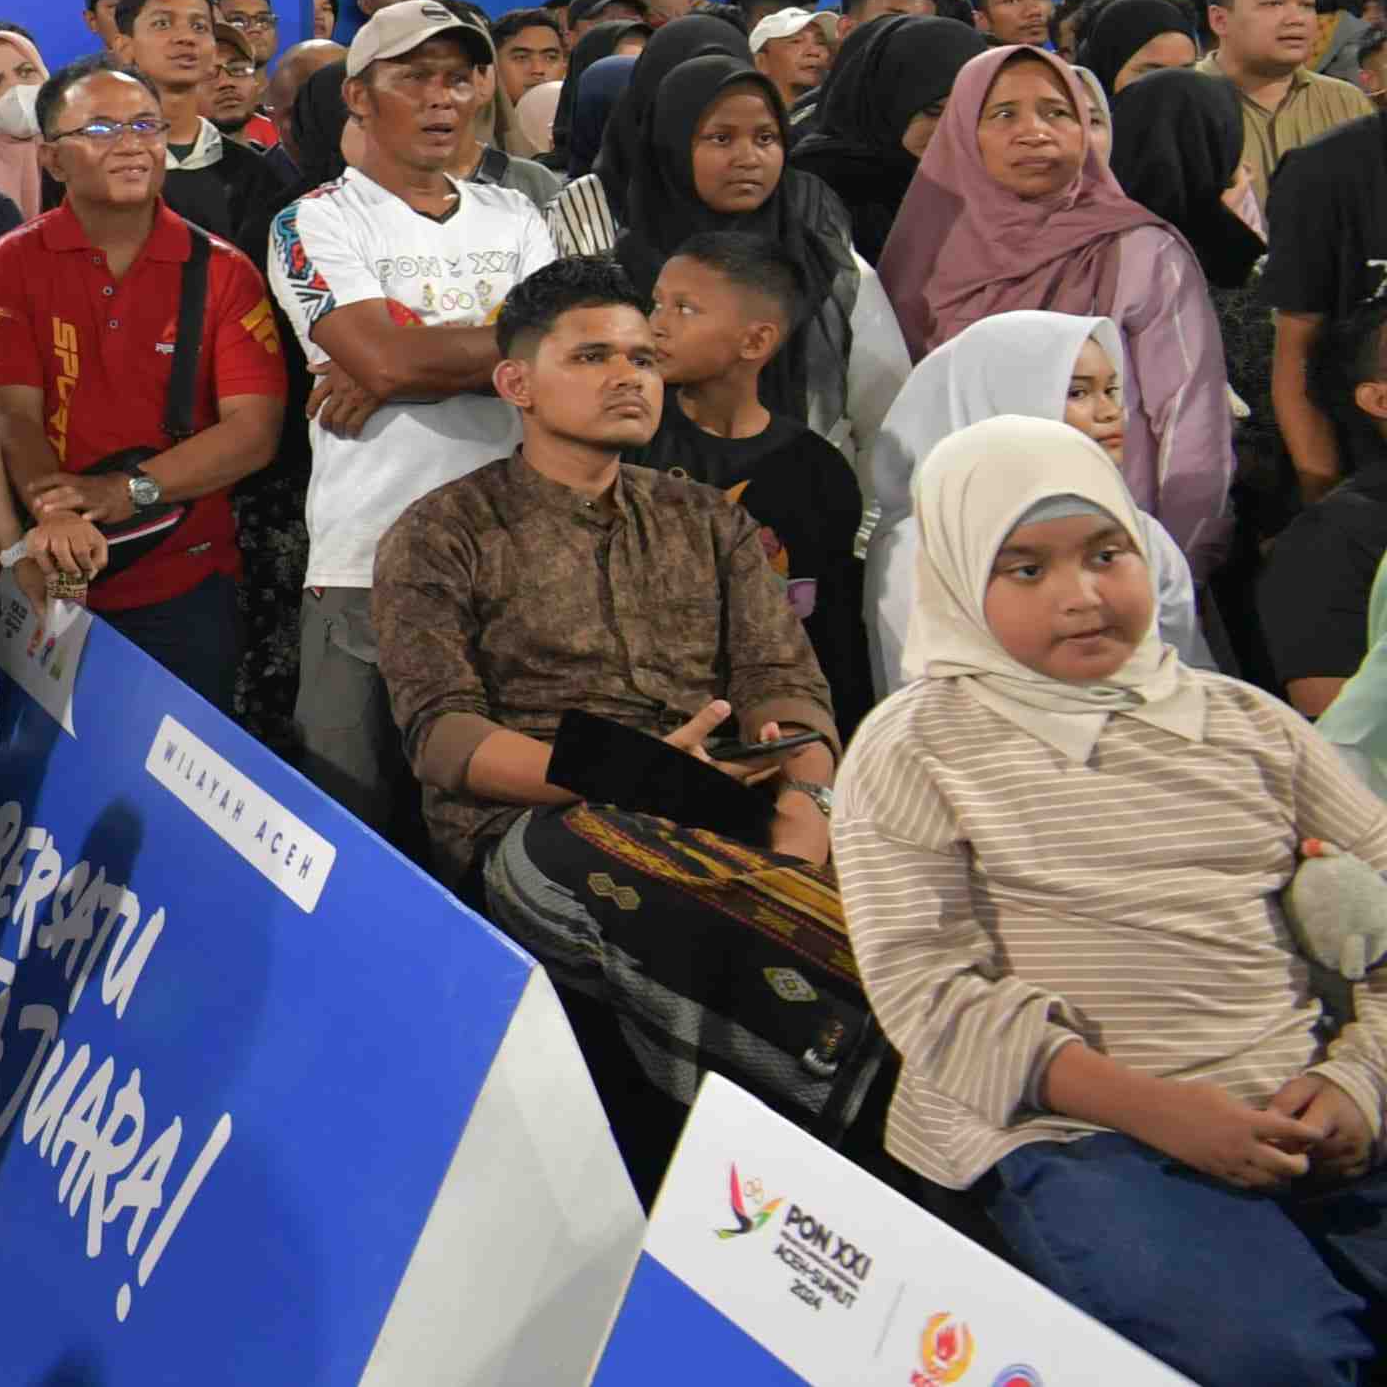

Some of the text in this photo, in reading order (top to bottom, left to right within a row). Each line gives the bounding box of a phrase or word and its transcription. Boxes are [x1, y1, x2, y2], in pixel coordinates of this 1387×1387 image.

[163, 740, 313, 880] WILAYAH ACEH
[785, 1204, 831, 1251] PON
[830, 1236, 873, 1282] XXI
